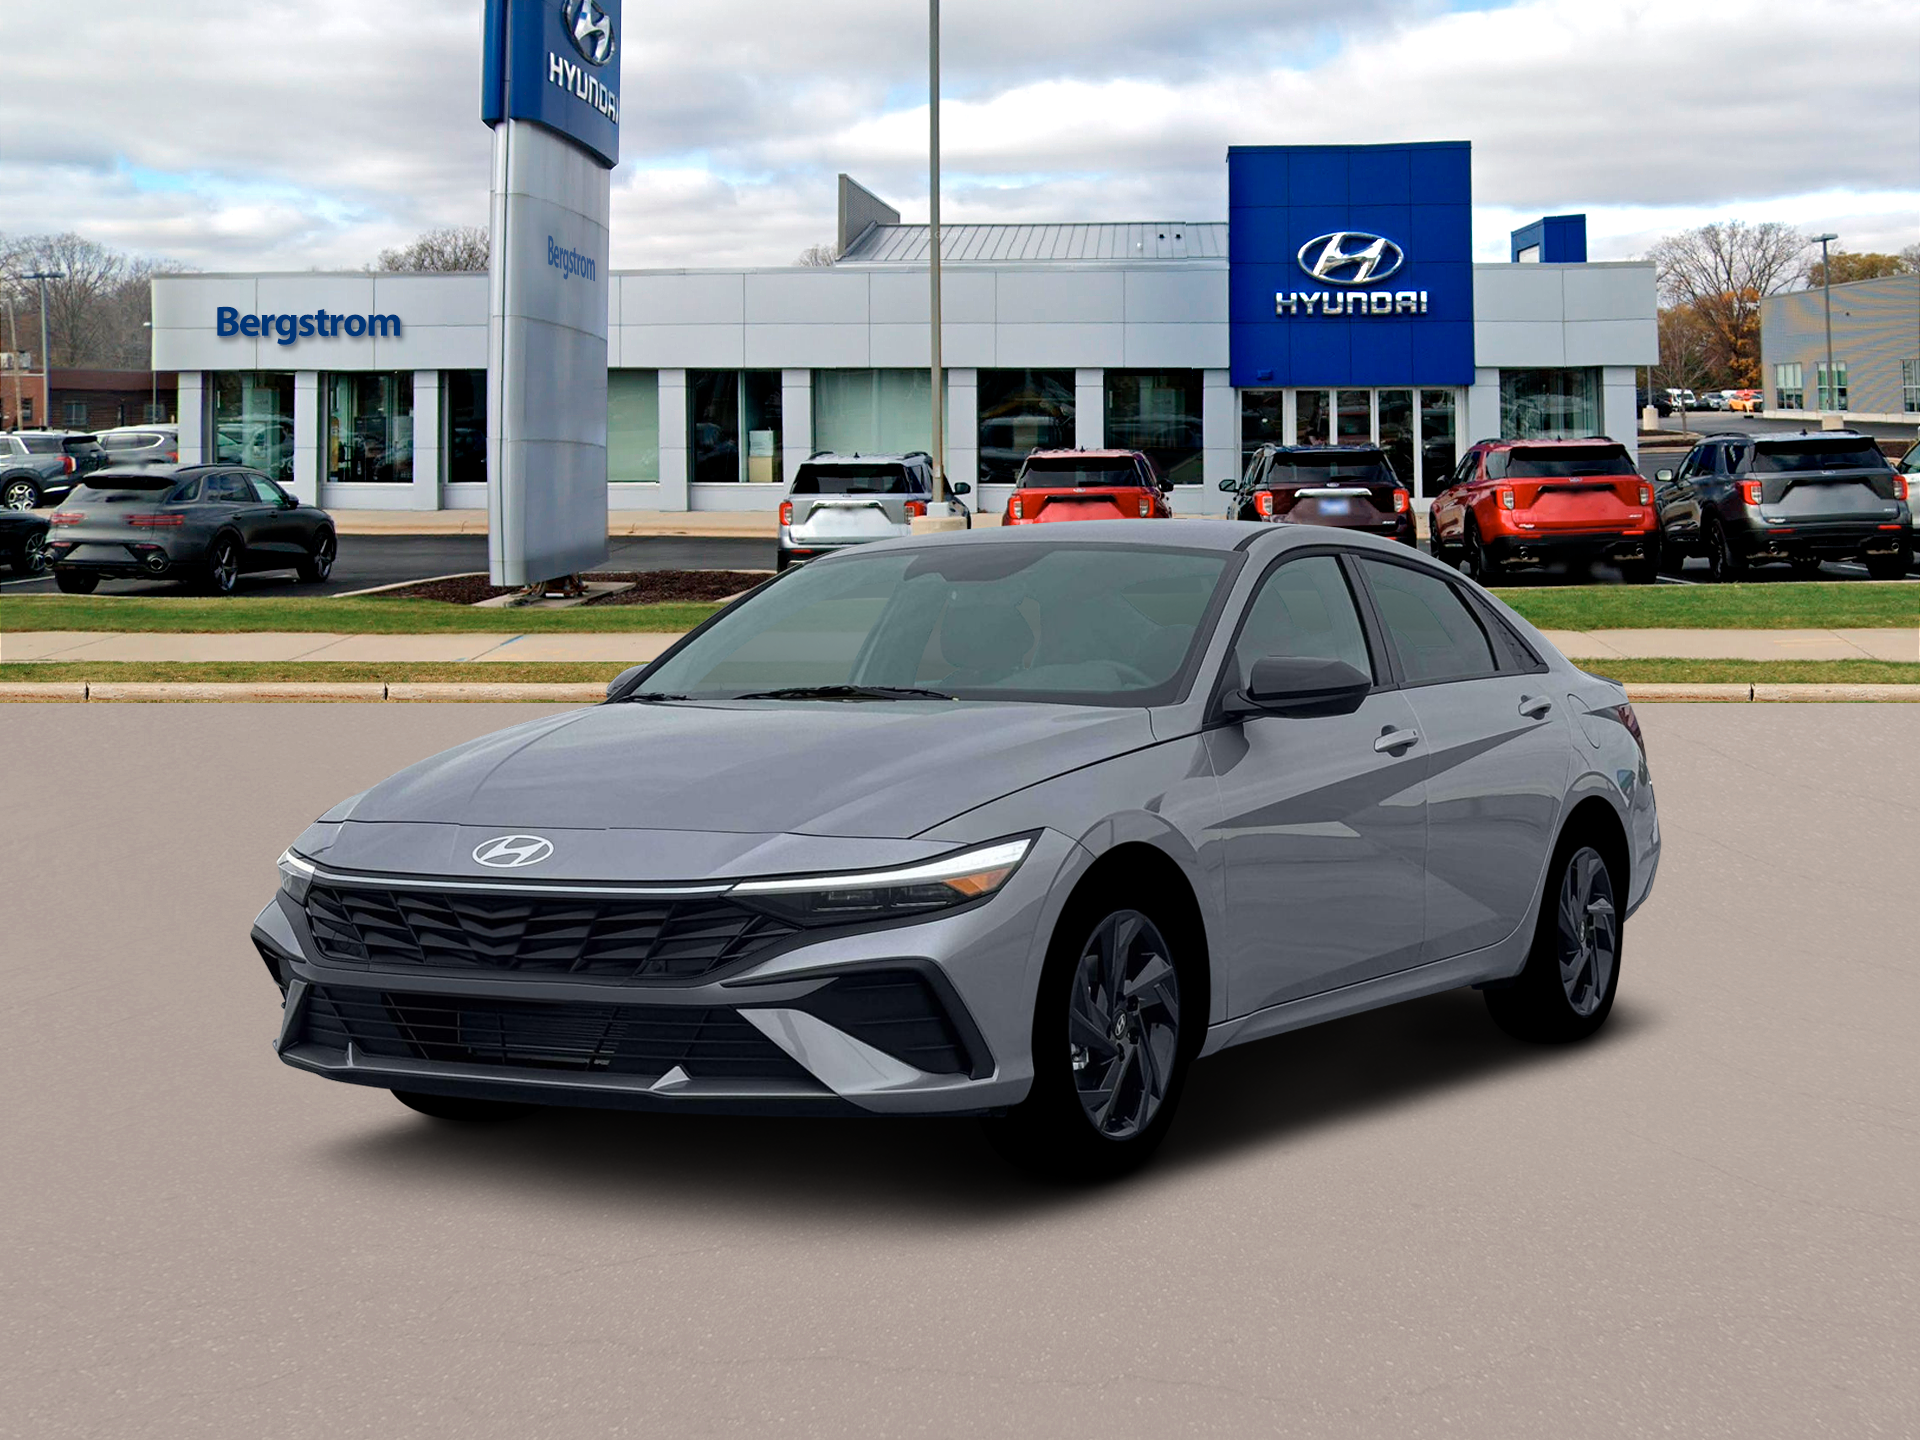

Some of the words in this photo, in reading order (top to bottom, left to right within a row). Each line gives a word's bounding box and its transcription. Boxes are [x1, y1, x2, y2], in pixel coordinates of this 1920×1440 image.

[548, 52, 619, 124] HYUNDAI
[547, 235, 596, 281] Bergstrom
[1275, 290, 1428, 315] HYUNDAI
[216, 306, 401, 345] Bergstrom
